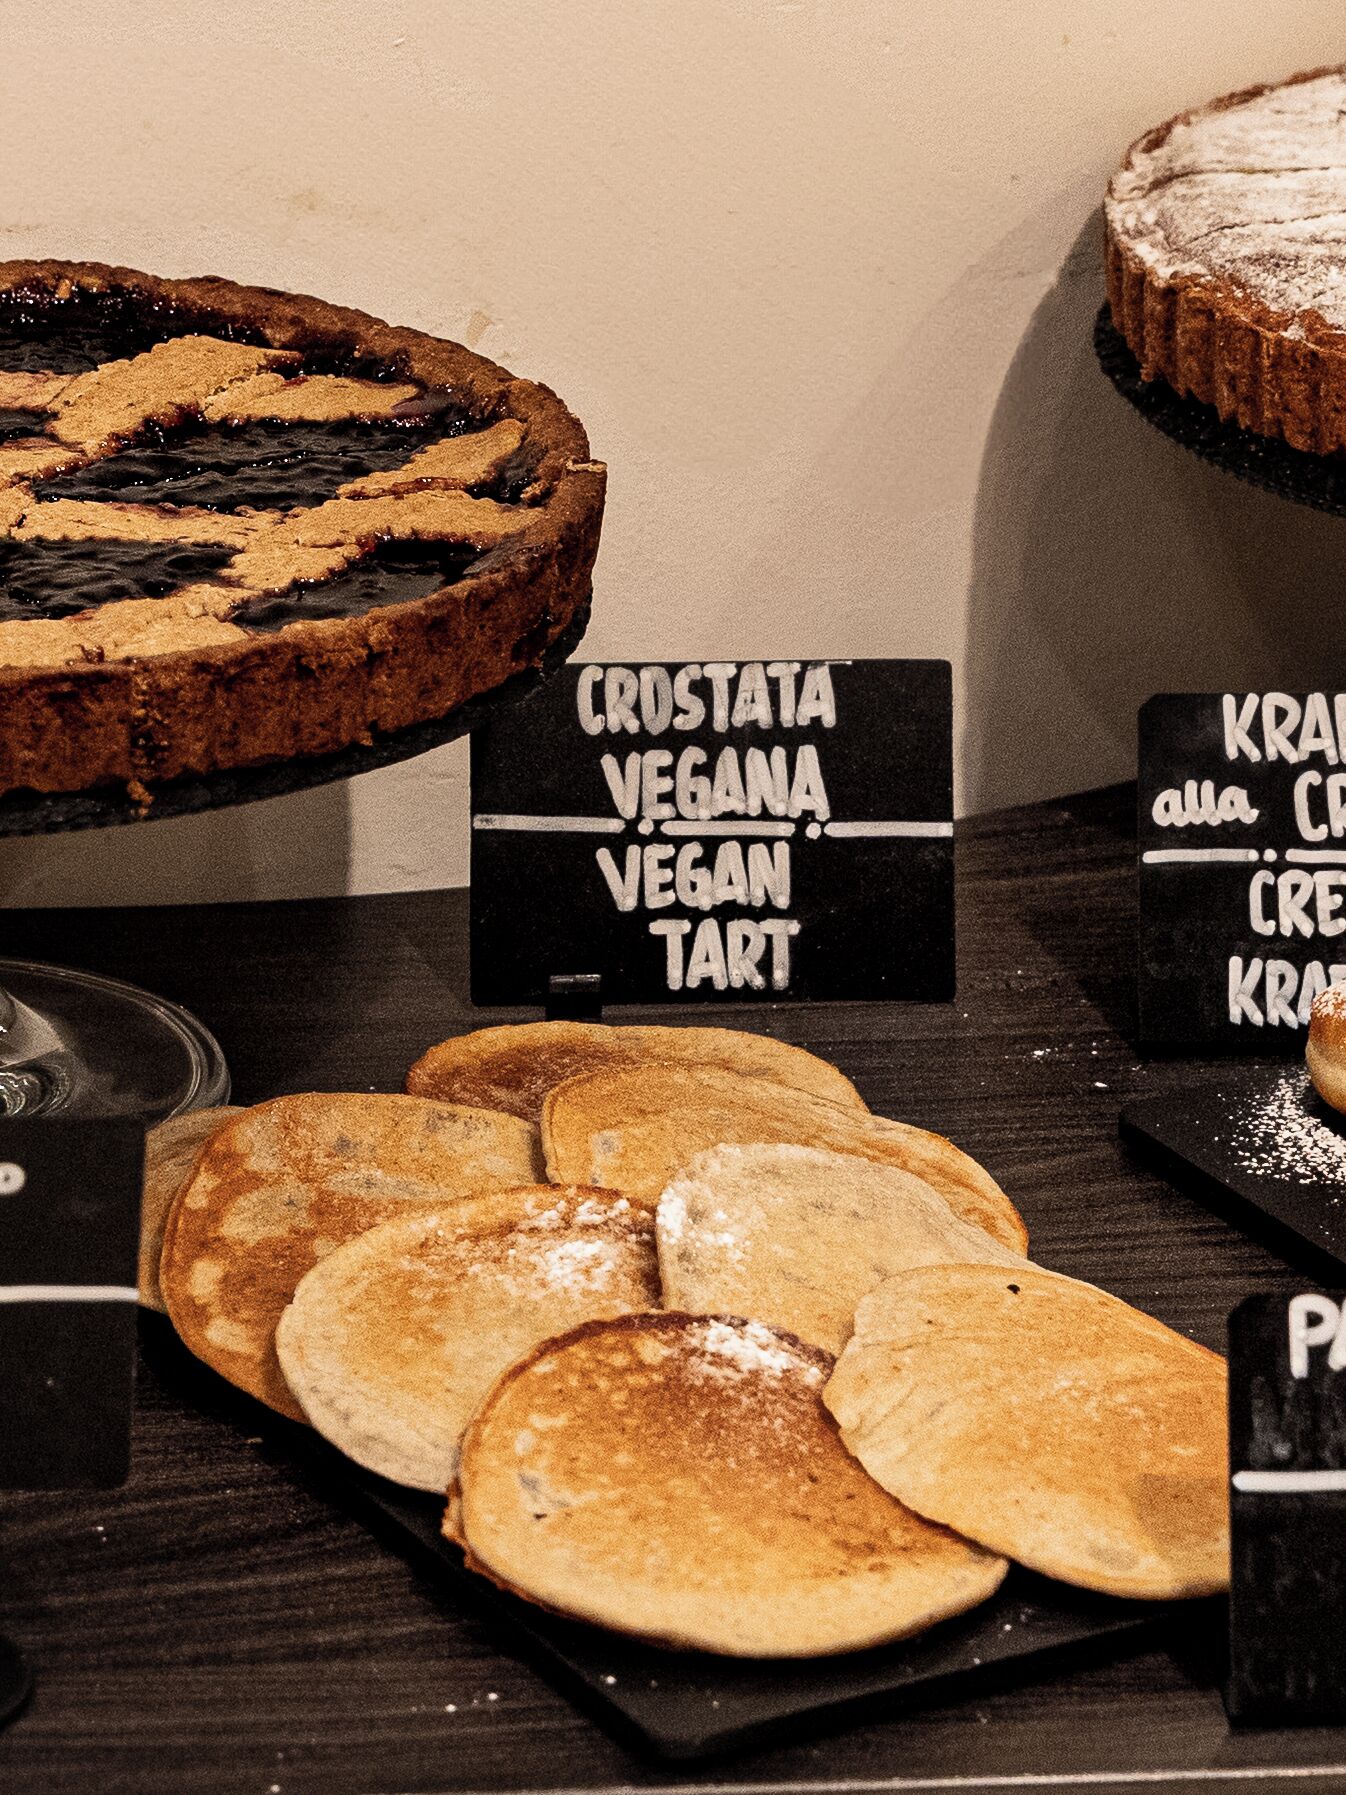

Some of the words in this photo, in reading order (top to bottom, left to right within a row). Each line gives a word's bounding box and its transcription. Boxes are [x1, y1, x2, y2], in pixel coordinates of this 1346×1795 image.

[577, 662, 837, 735] CROSTATA
[600, 744, 831, 821] VEGANA
[1151, 779, 1260, 828] alla
[595, 840, 791, 912] VEGAN
[648, 917, 801, 991] TART
